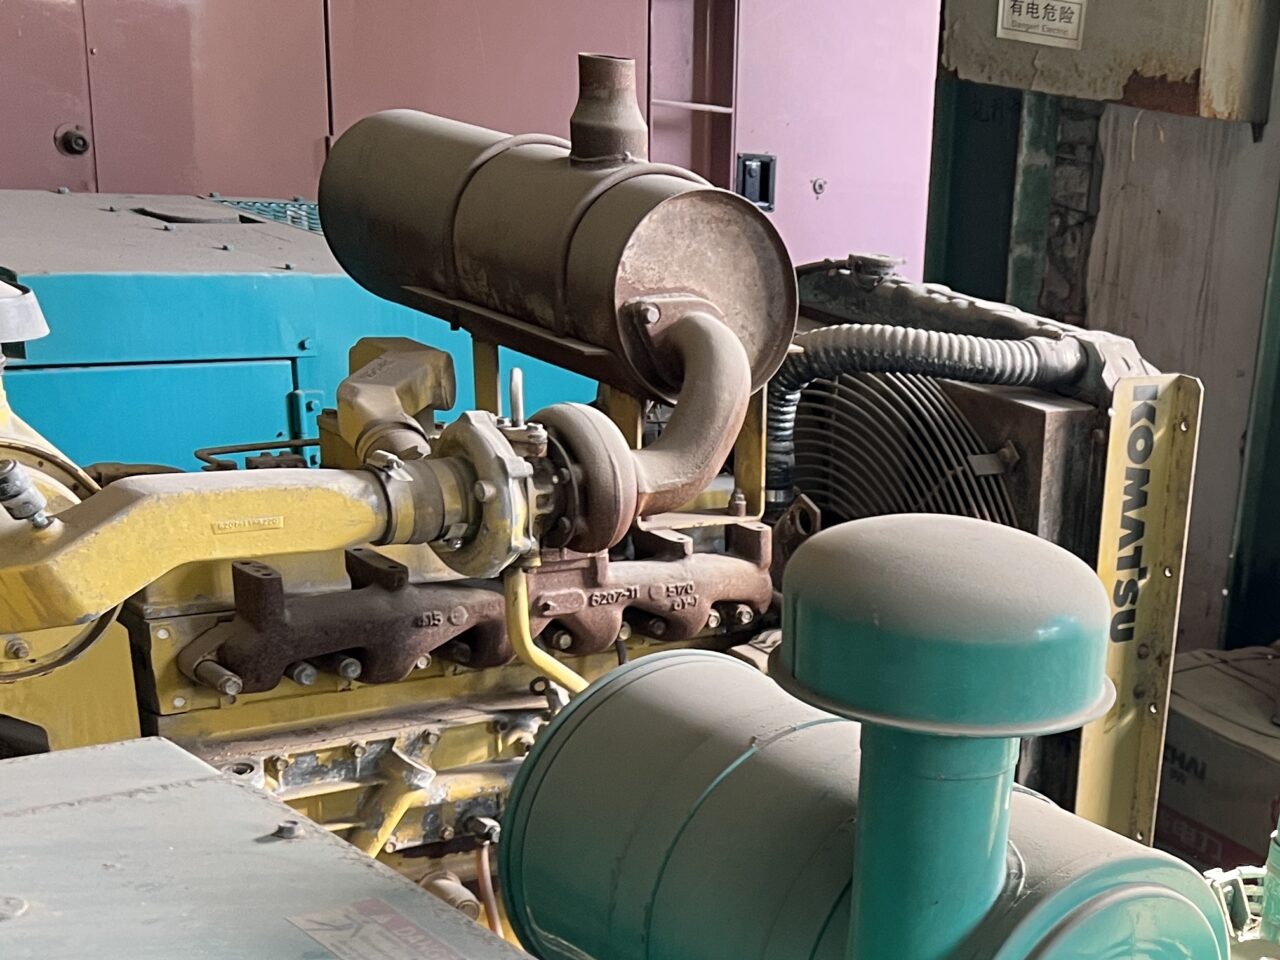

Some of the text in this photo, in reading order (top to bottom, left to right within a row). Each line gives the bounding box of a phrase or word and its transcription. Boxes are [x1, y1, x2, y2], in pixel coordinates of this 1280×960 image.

[1010, 0, 1075, 24] 有电危险
[1109, 384, 1159, 644] KOMATSU
